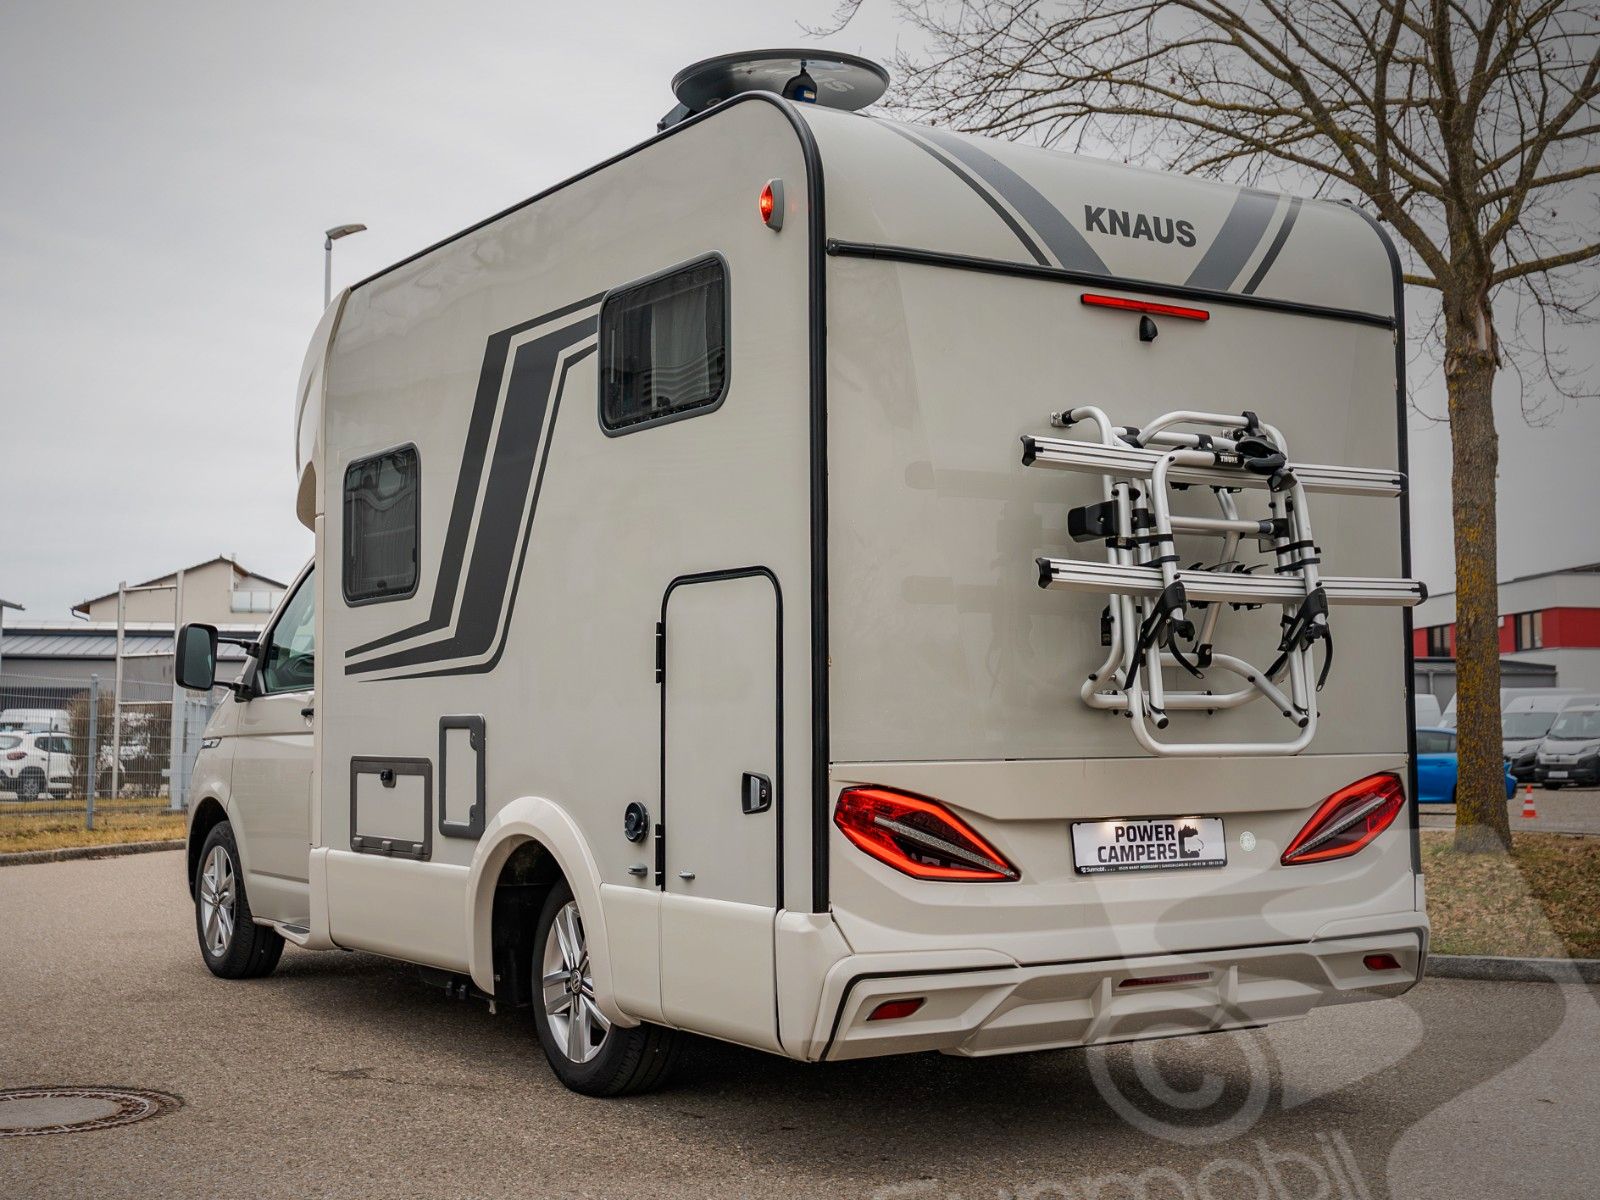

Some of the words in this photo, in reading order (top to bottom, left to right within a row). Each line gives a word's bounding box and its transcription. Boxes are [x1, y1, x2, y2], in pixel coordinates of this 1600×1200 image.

[1084, 204, 1197, 247] KNAUS
[1114, 824, 1176, 843] POWER
[1097, 843, 1178, 863] CAMPERS
